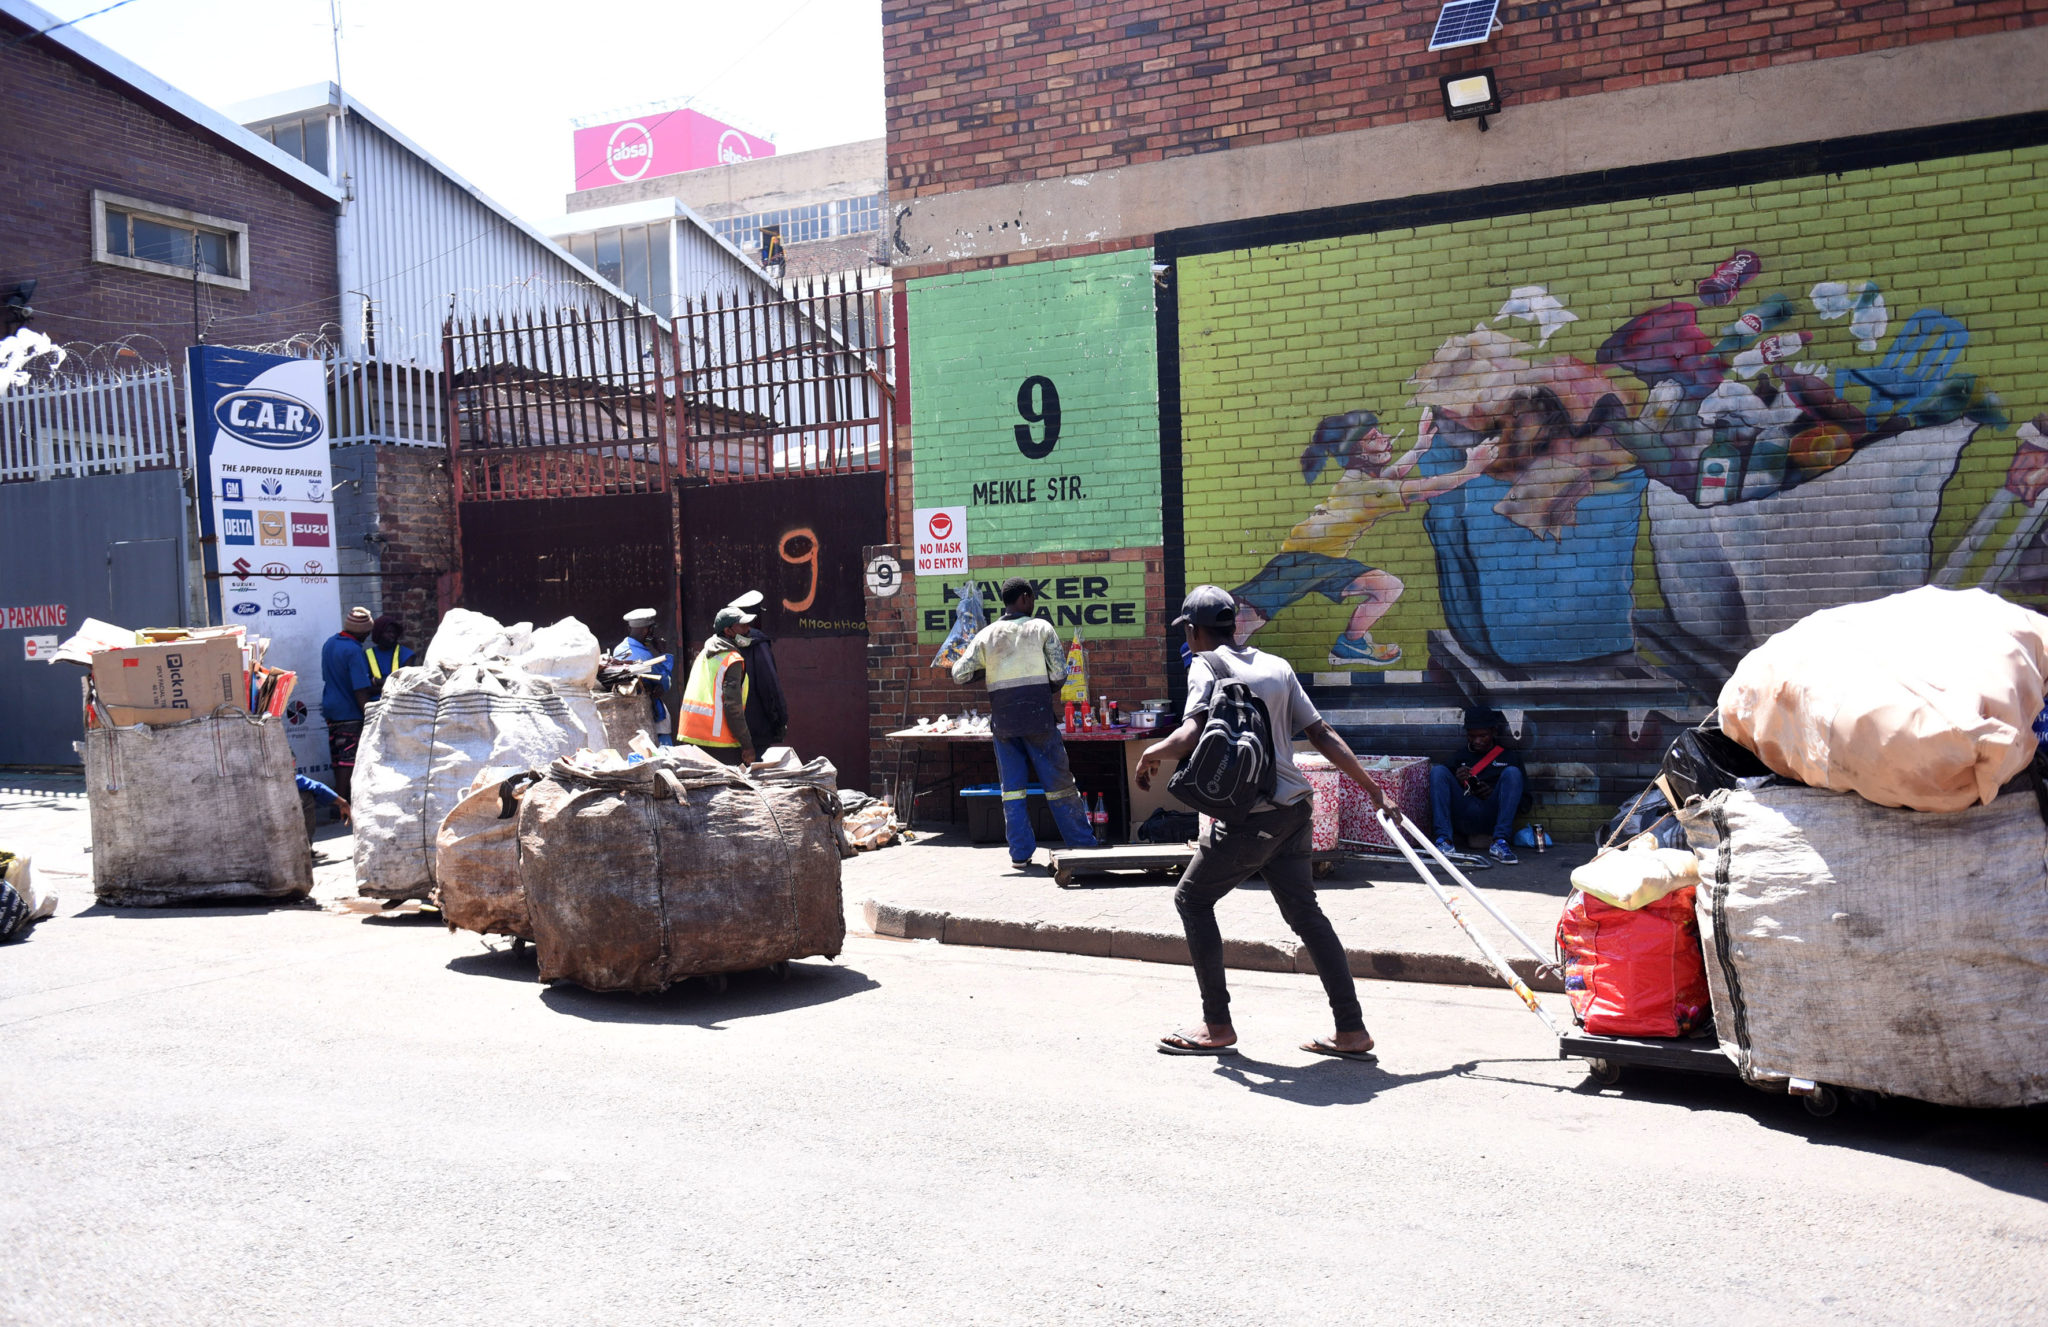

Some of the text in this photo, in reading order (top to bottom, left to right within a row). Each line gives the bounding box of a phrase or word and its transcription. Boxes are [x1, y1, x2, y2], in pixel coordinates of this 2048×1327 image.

[613, 142, 647, 161] absa
[230, 399, 313, 433] C.A.R.
[1014, 375, 1061, 460] 9
[222, 463, 323, 478] THE APPROVED REPAIRER
[225, 482, 240, 494] GM
[973, 475, 1087, 506] MEIKLE STR.
[224, 518, 253, 536] DELTA
[292, 523, 328, 536] ISUZU
[263, 538, 285, 546] OPEL
[920, 542, 962, 554] NO MASK
[779, 527, 818, 612] 9
[918, 557, 964, 570] NO ENTRY
[266, 566, 286, 576] KIA
[877, 564, 893, 588] 9
[300, 576, 328, 584] TOYOTA
[237, 603, 257, 613] Ford
[267, 608, 297, 616] mazda
[8, 604, 67, 628] PARKING
